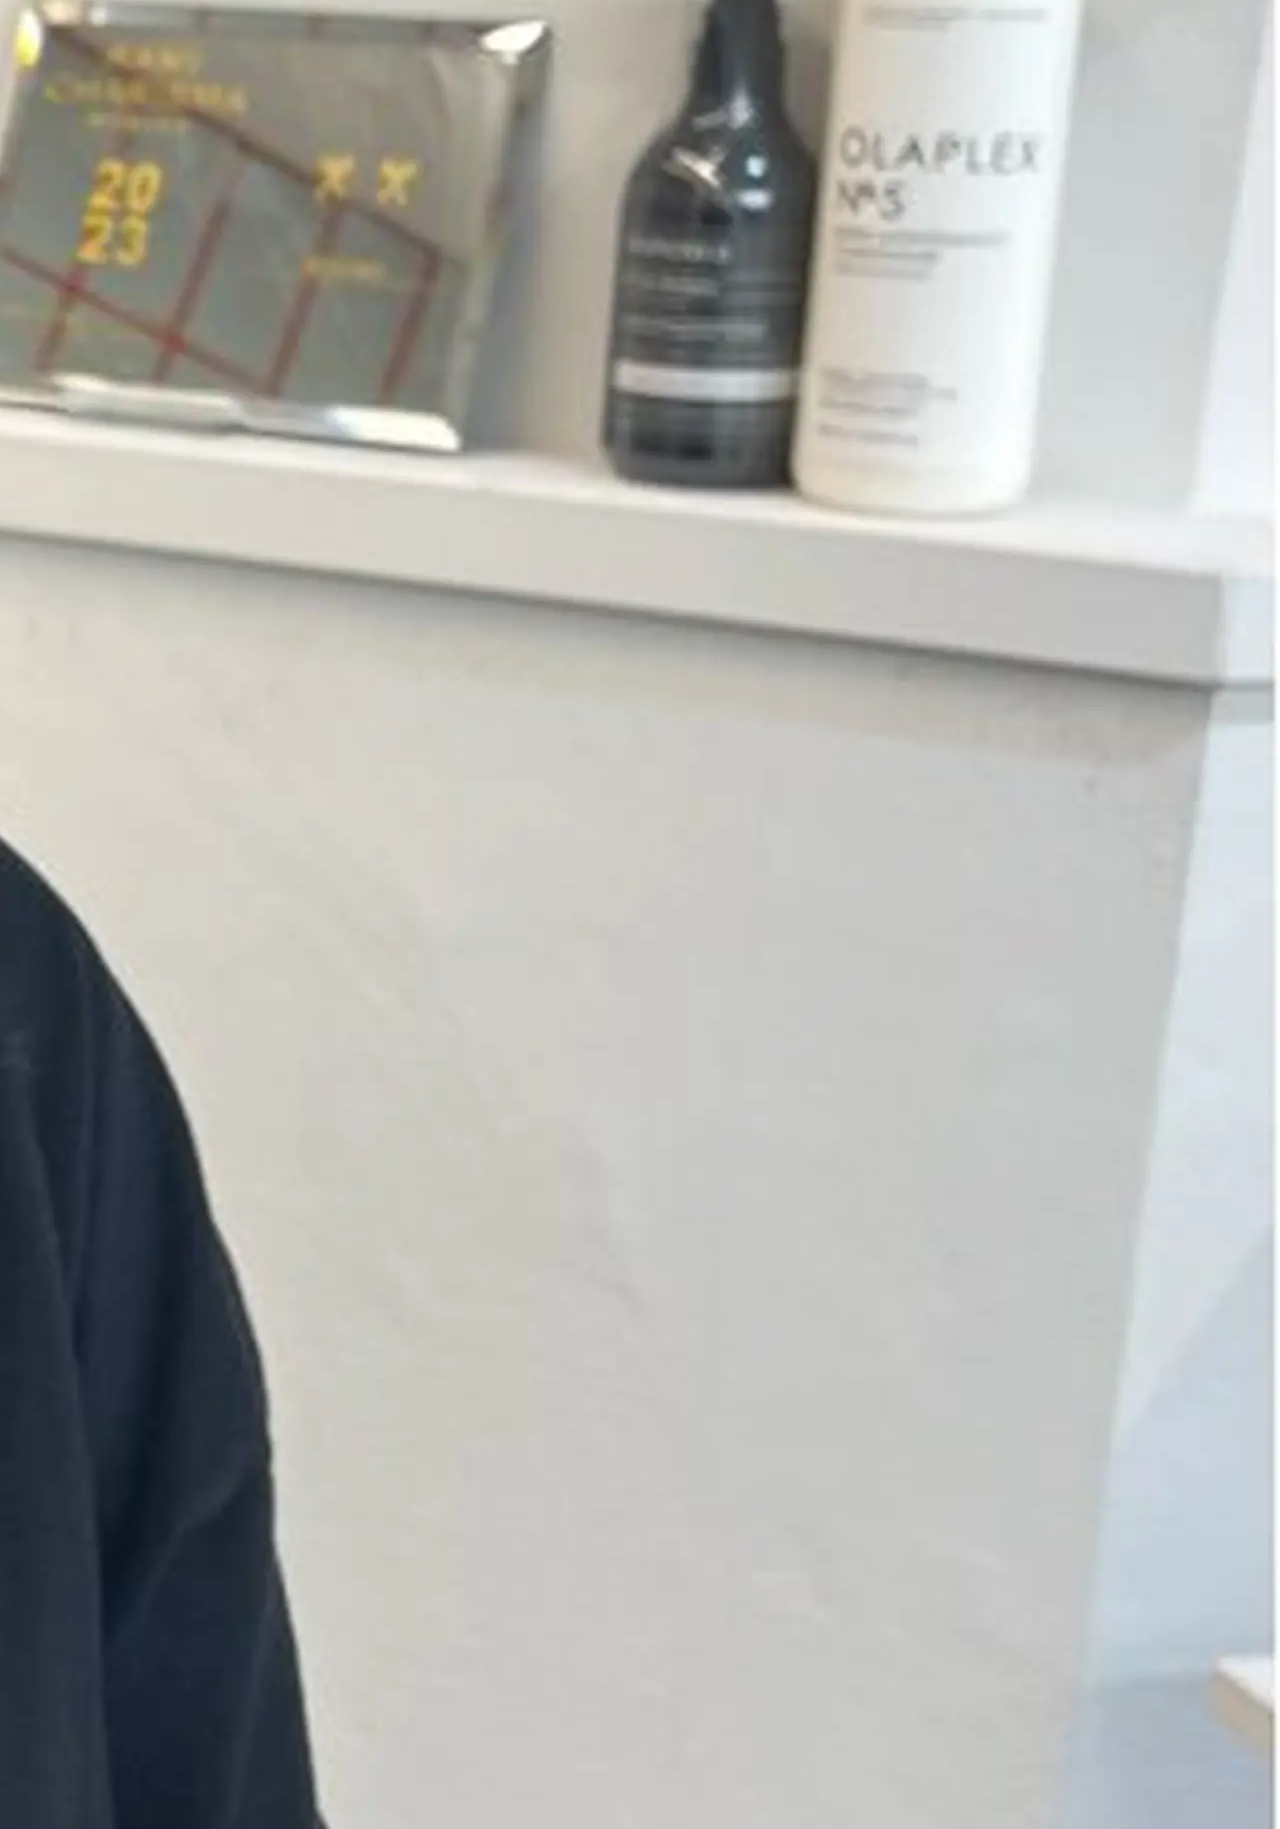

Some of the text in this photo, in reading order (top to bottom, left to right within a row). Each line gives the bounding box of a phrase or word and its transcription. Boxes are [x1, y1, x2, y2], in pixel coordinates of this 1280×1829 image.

[838, 124, 1043, 176] OLAPLEX
[87, 157, 165, 214] 20
[76, 215, 151, 271] 23
